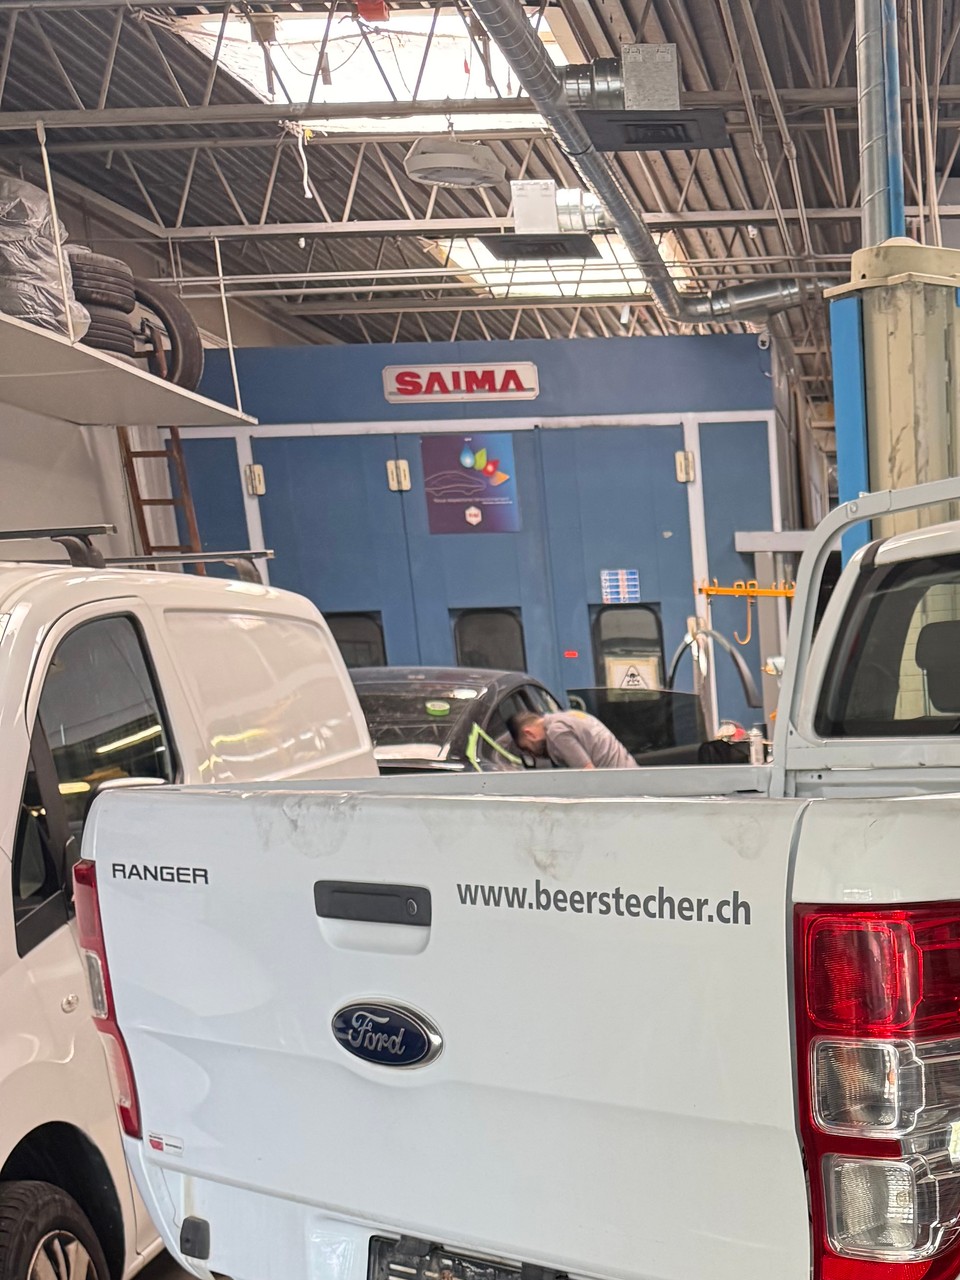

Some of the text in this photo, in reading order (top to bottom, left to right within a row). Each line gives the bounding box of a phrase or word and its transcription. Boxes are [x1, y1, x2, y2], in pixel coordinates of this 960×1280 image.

[395, 369, 525, 396] SAIMA
[111, 863, 209, 885] RANGER
[456, 879, 751, 925] www.beerstecher.ch
[348, 1010, 406, 1055] Ford
